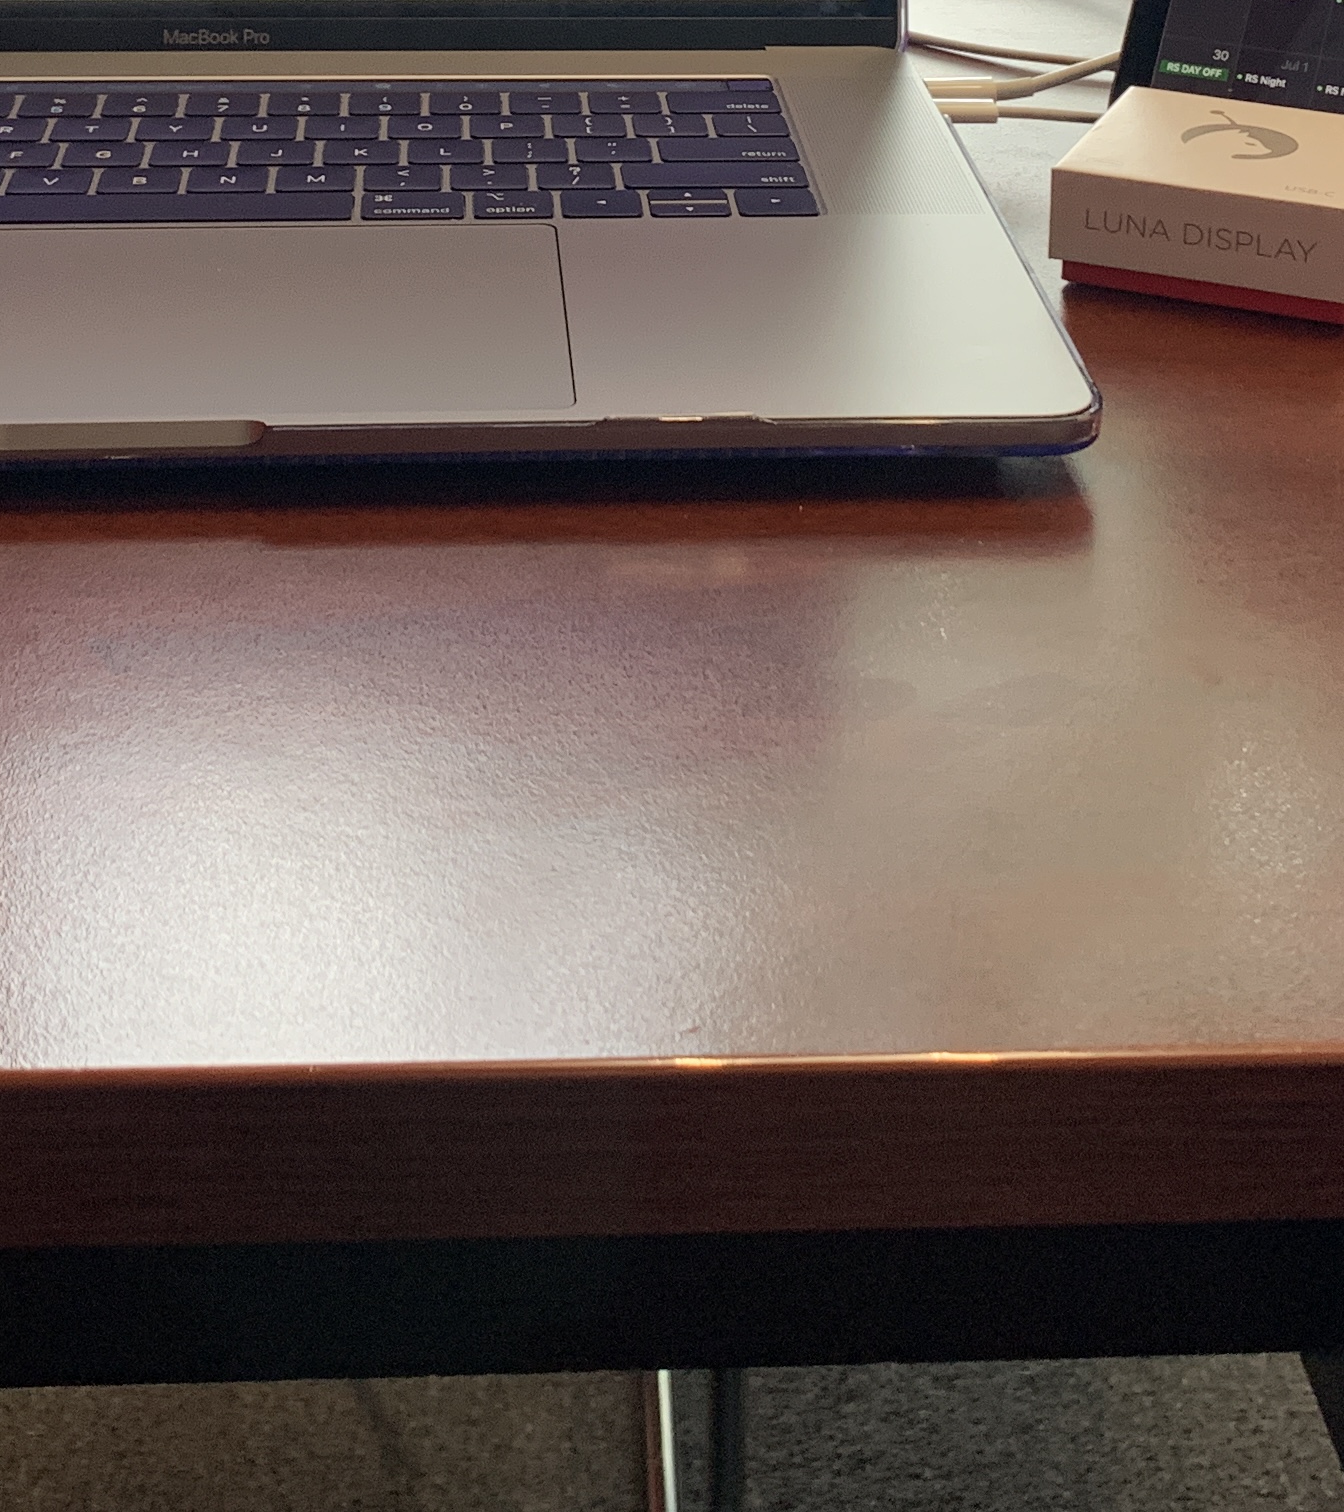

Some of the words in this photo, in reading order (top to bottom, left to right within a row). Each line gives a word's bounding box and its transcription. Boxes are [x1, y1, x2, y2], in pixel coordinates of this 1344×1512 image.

[163, 28, 238, 45] MacBook
[243, 29, 270, 45] Pro
[0, 126, 14, 134] R
[170, 125, 184, 133] Y
[1284, 185, 1336, 198] USB-C
[1085, 208, 1170, 241] LUNA
[1182, 223, 1318, 263] DISPLAY
